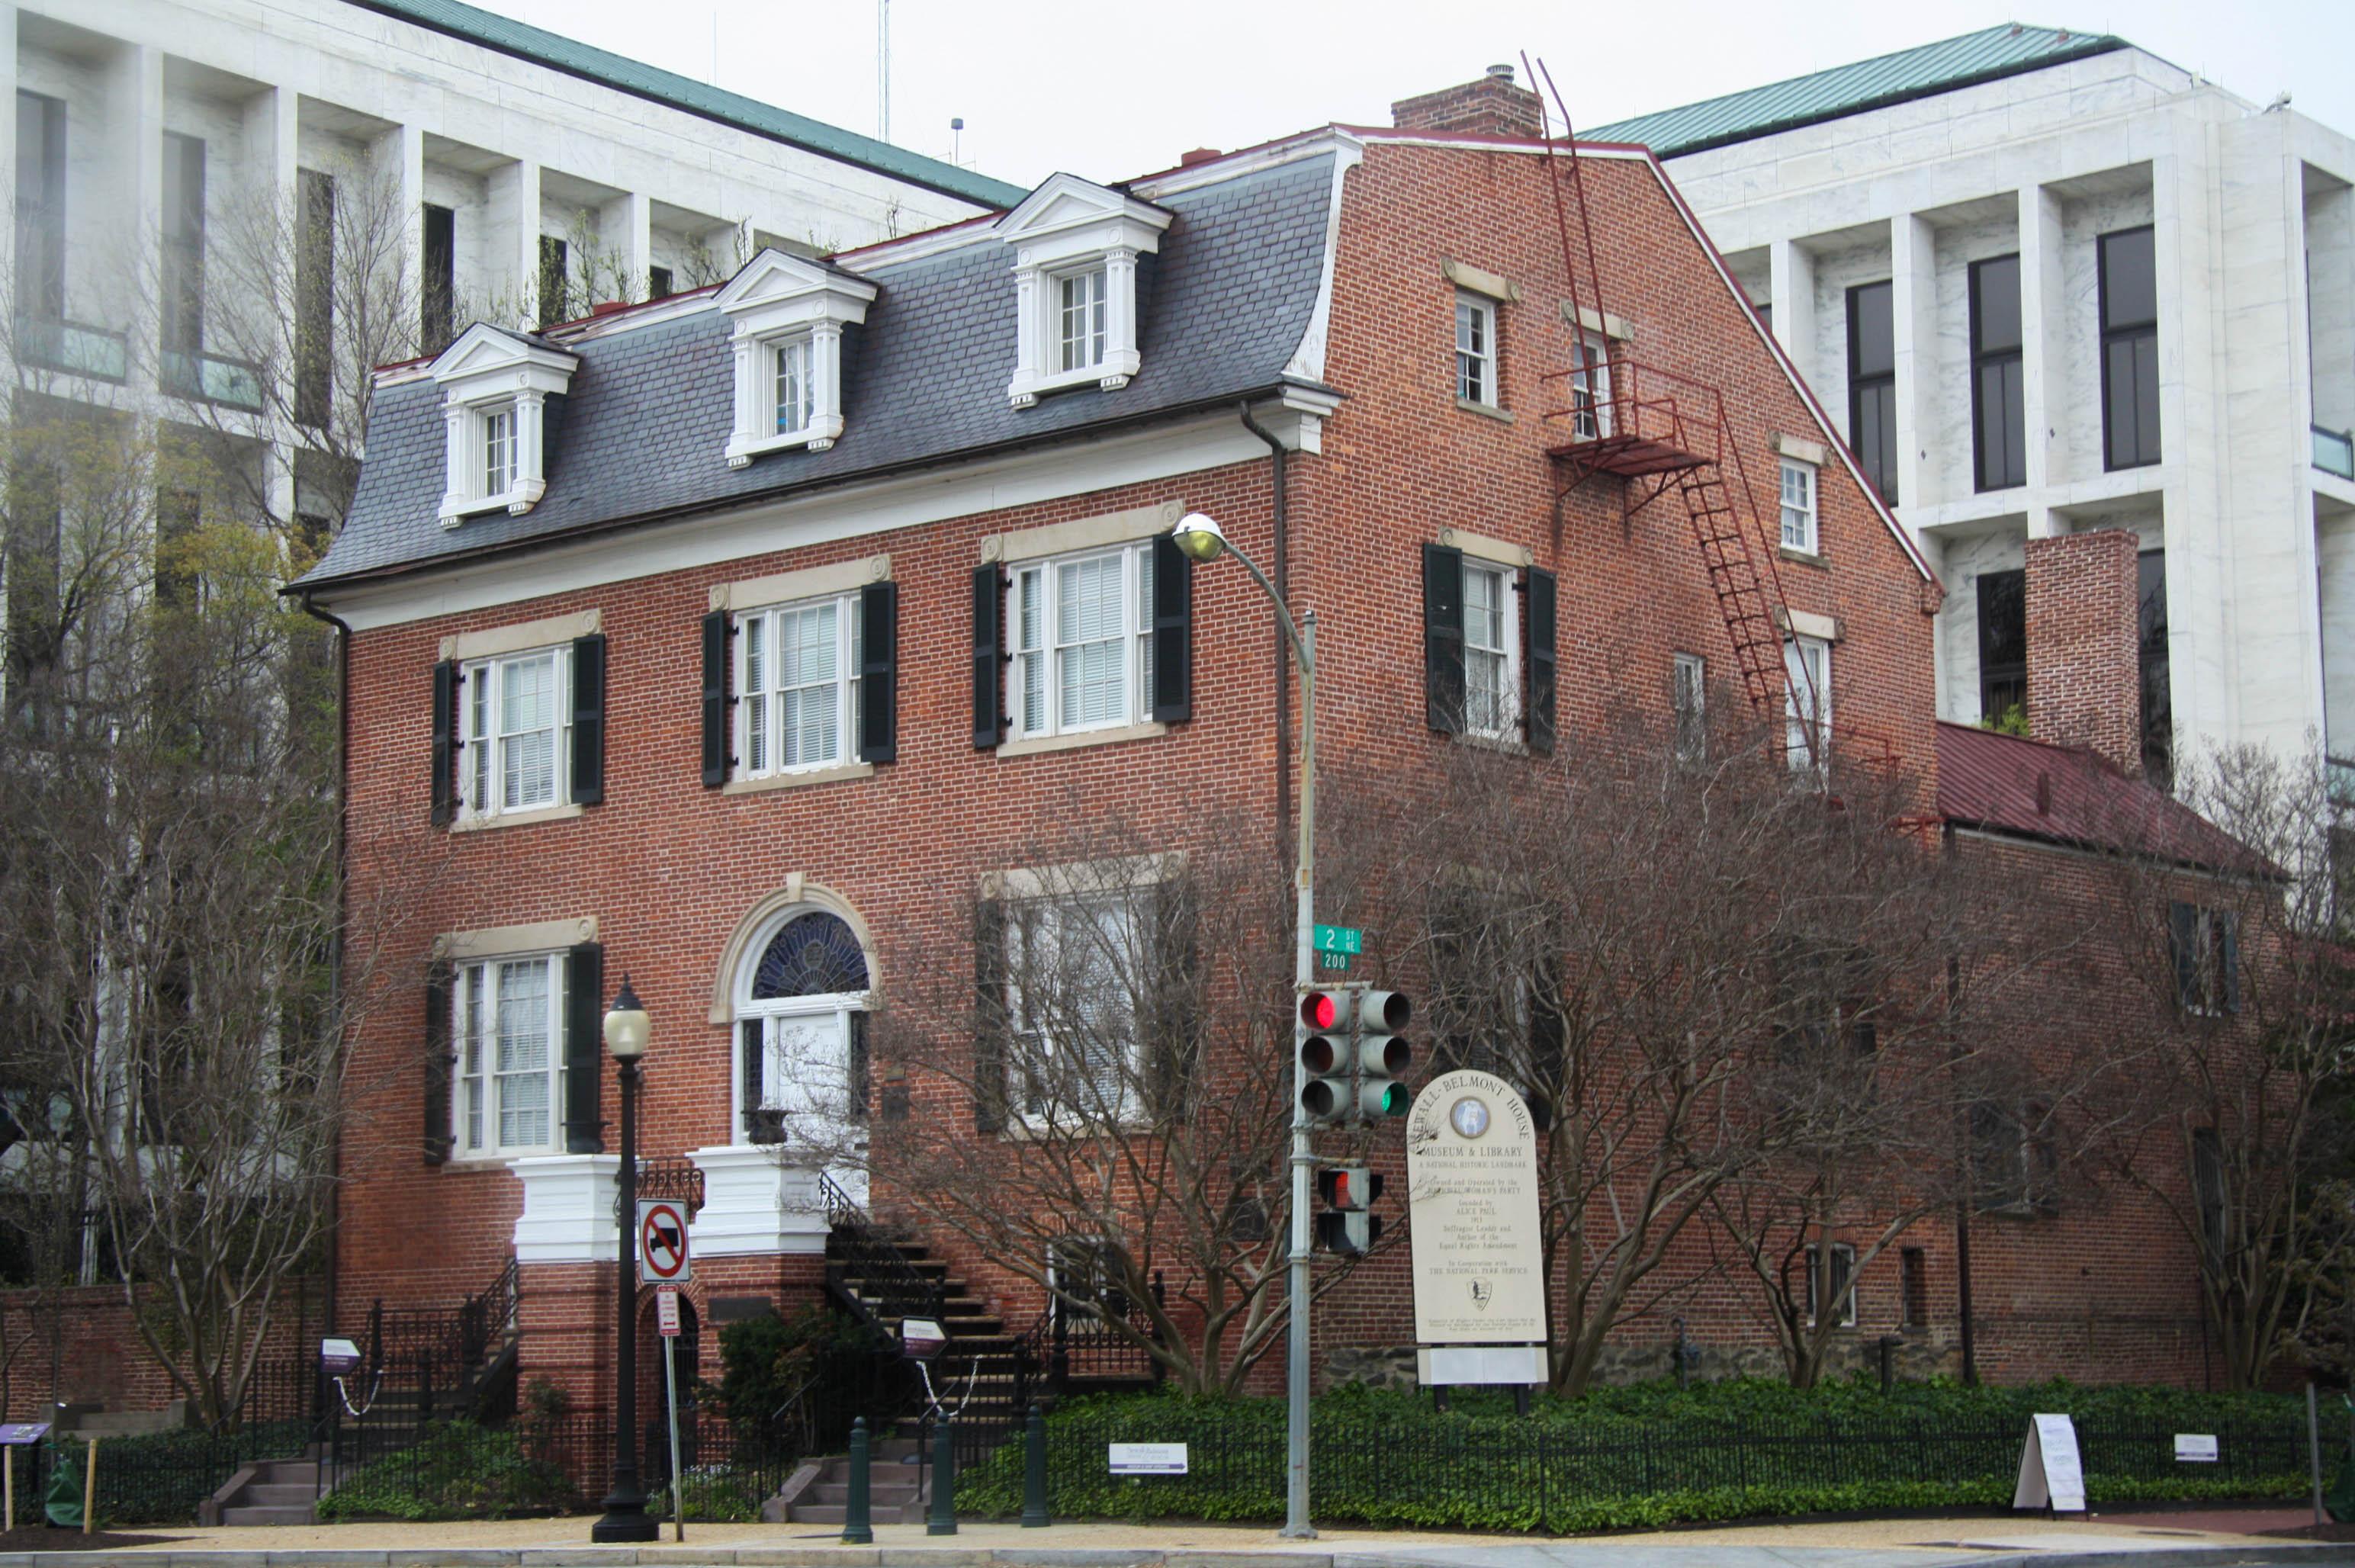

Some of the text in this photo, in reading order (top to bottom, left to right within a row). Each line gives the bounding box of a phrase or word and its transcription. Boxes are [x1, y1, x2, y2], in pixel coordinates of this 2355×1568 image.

[1325, 928, 1335, 949] 2
[1345, 930, 1355, 940] ST
[1345, 941, 1355, 952] NE
[1325, 953, 1345, 969] 200
[1507, 1097, 1531, 1141] HOUSE
[1423, 1146, 1523, 1157] MUSEUM & LIBRARY
[1426, 1161, 1457, 1169] NATIONAL
[1459, 1161, 1488, 1169] HISTORIC
[1491, 1161, 1527, 1169] LANDMARK
[1454, 1178, 1465, 1186] and
[1498, 1178, 1505, 1188] by
[1508, 1178, 1518, 1186] the
[1499, 1187, 1521, 1195] PARTY
[1457, 1207, 1476, 1216] ALICE
[1428, 1267, 1528, 1276] THE NATIONAL PARK SERVICE
